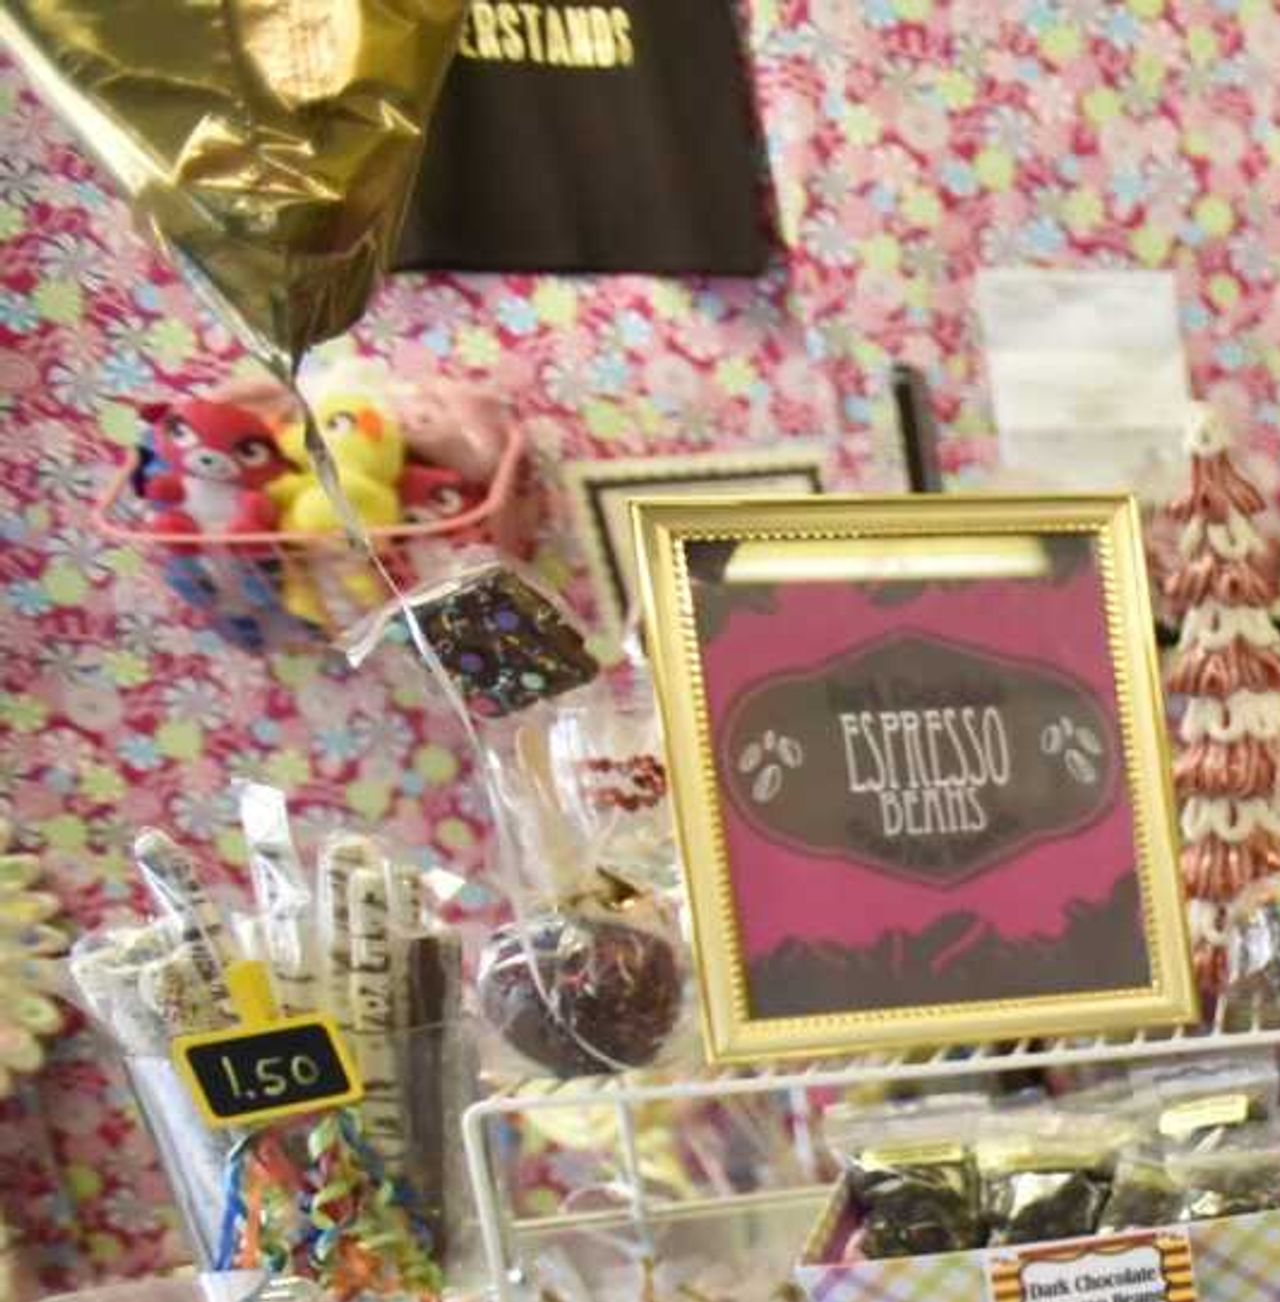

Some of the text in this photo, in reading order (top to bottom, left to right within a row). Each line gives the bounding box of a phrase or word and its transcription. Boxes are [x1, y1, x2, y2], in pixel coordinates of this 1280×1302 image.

[838, 706, 1011, 793] ESPRESSO
[878, 786, 989, 836] BEANS
[221, 1055, 320, 1100] 1.50
[1029, 1265, 1157, 1300] Dark Chocolate
